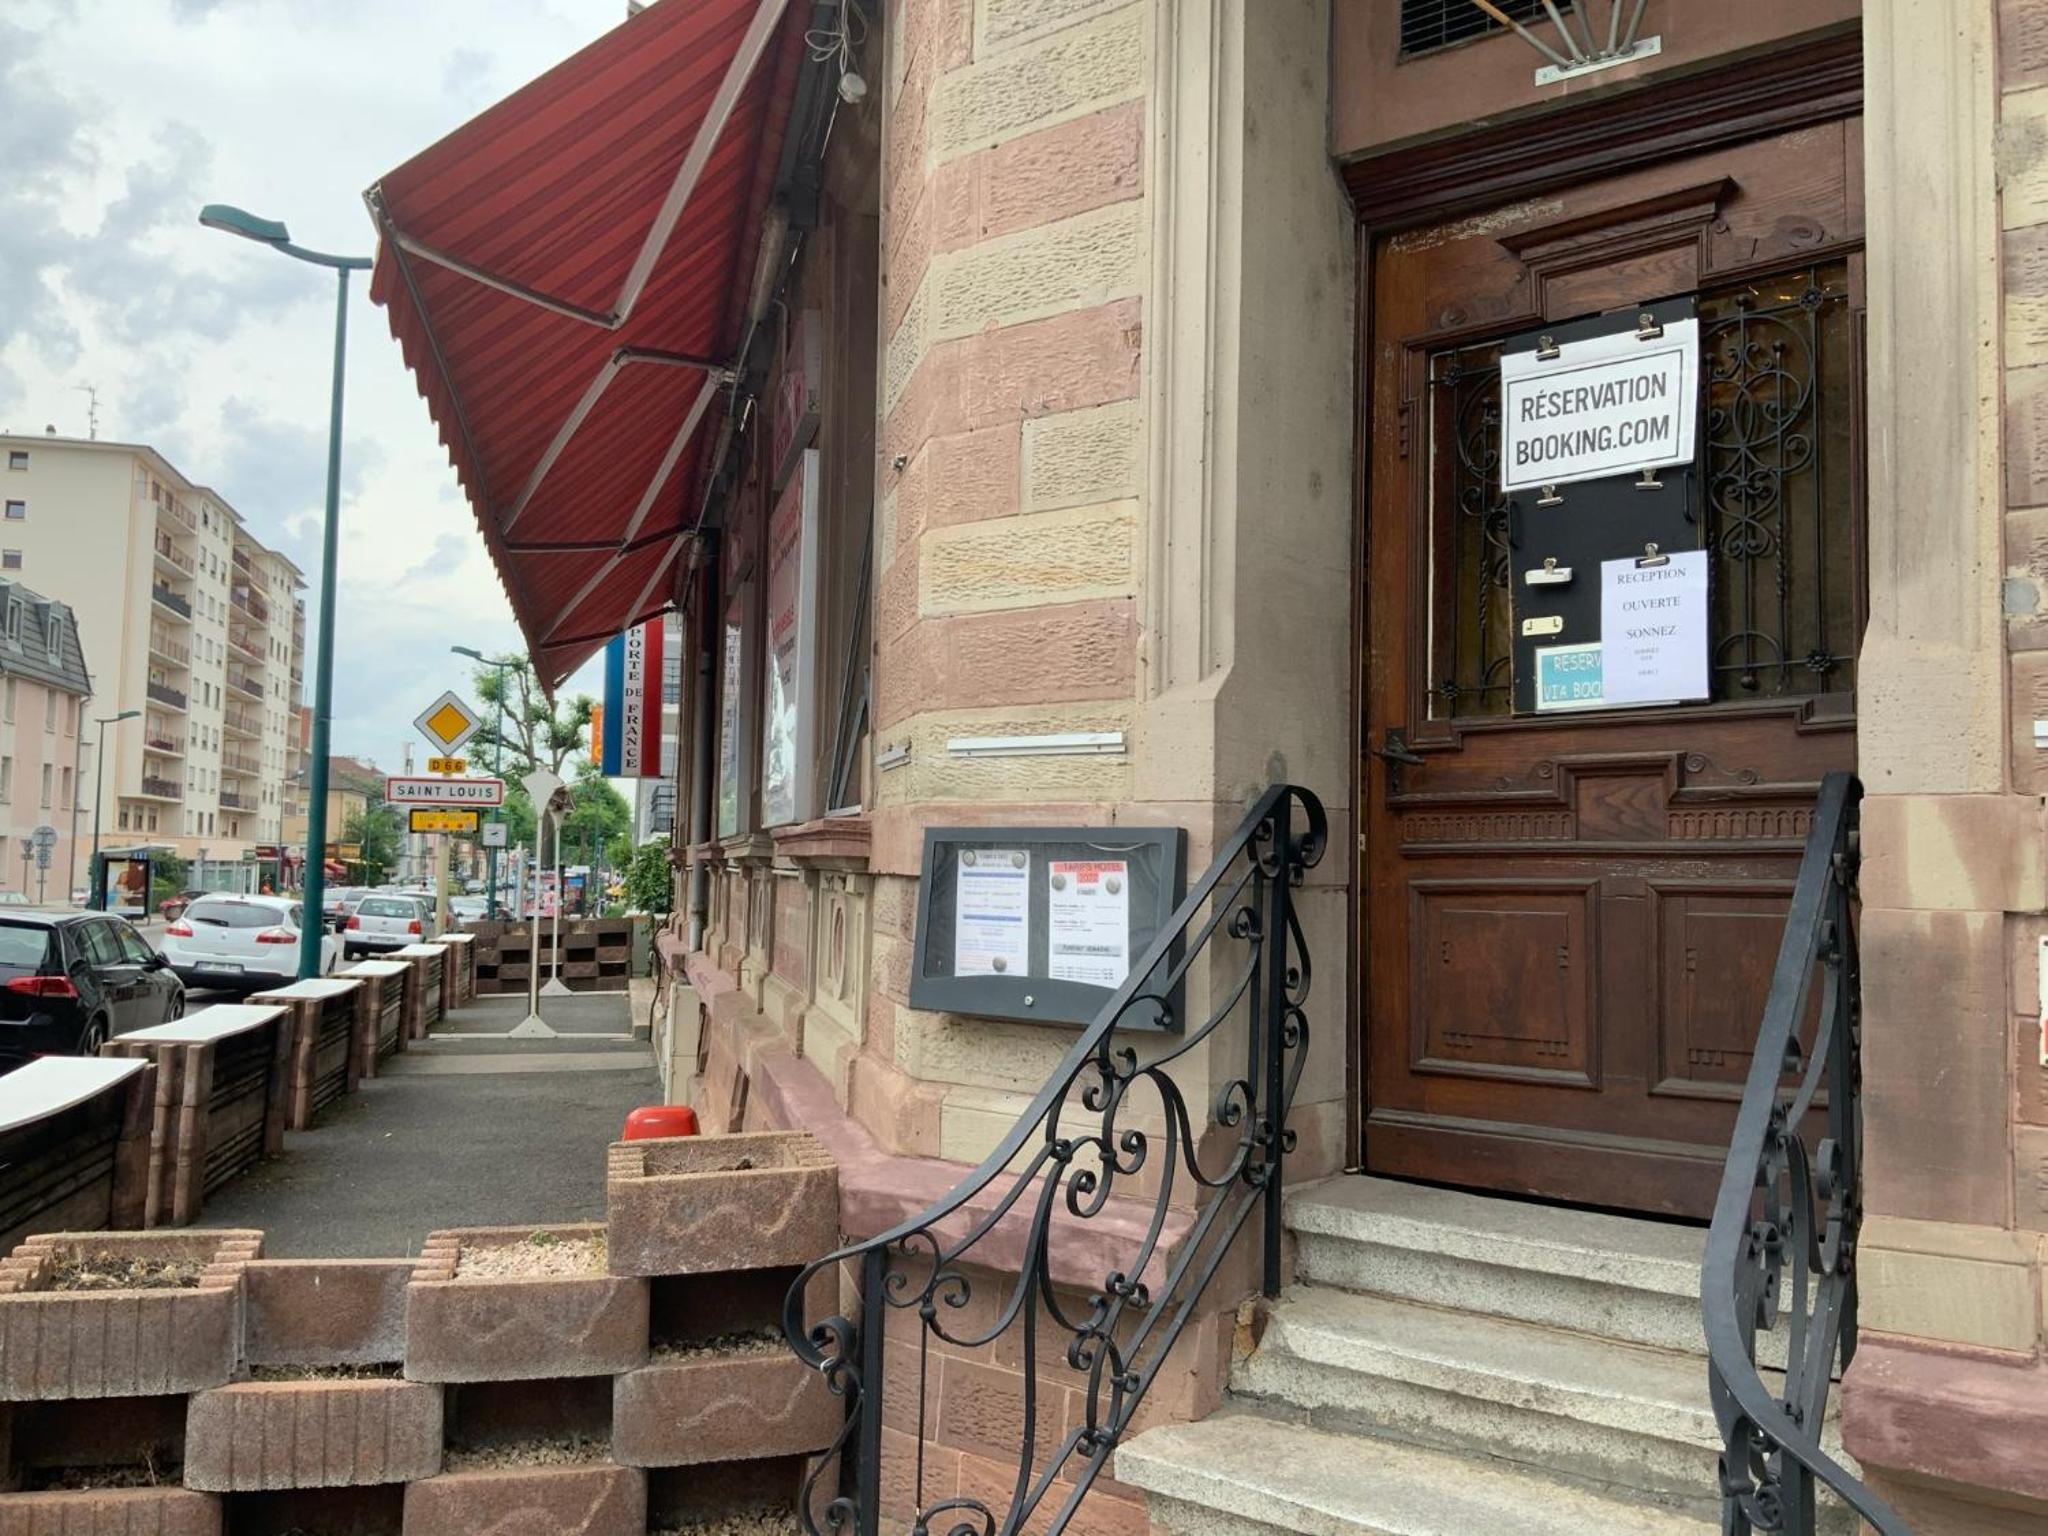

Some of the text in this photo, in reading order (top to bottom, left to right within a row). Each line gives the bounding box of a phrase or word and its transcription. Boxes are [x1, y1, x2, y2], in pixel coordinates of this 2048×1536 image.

[1520, 370, 1668, 424] RÉSERVATION
[1516, 415, 1670, 466] BOOKING.COM
[1616, 568, 1687, 585] RECEPTION
[1621, 596, 1681, 612] OUVERTE
[1626, 625, 1677, 640] SONNEZ
[625, 628, 643, 768] PORTE DE FRANCE
[431, 761, 463, 770] D 66
[397, 785, 494, 798] SAINT LOUIS
